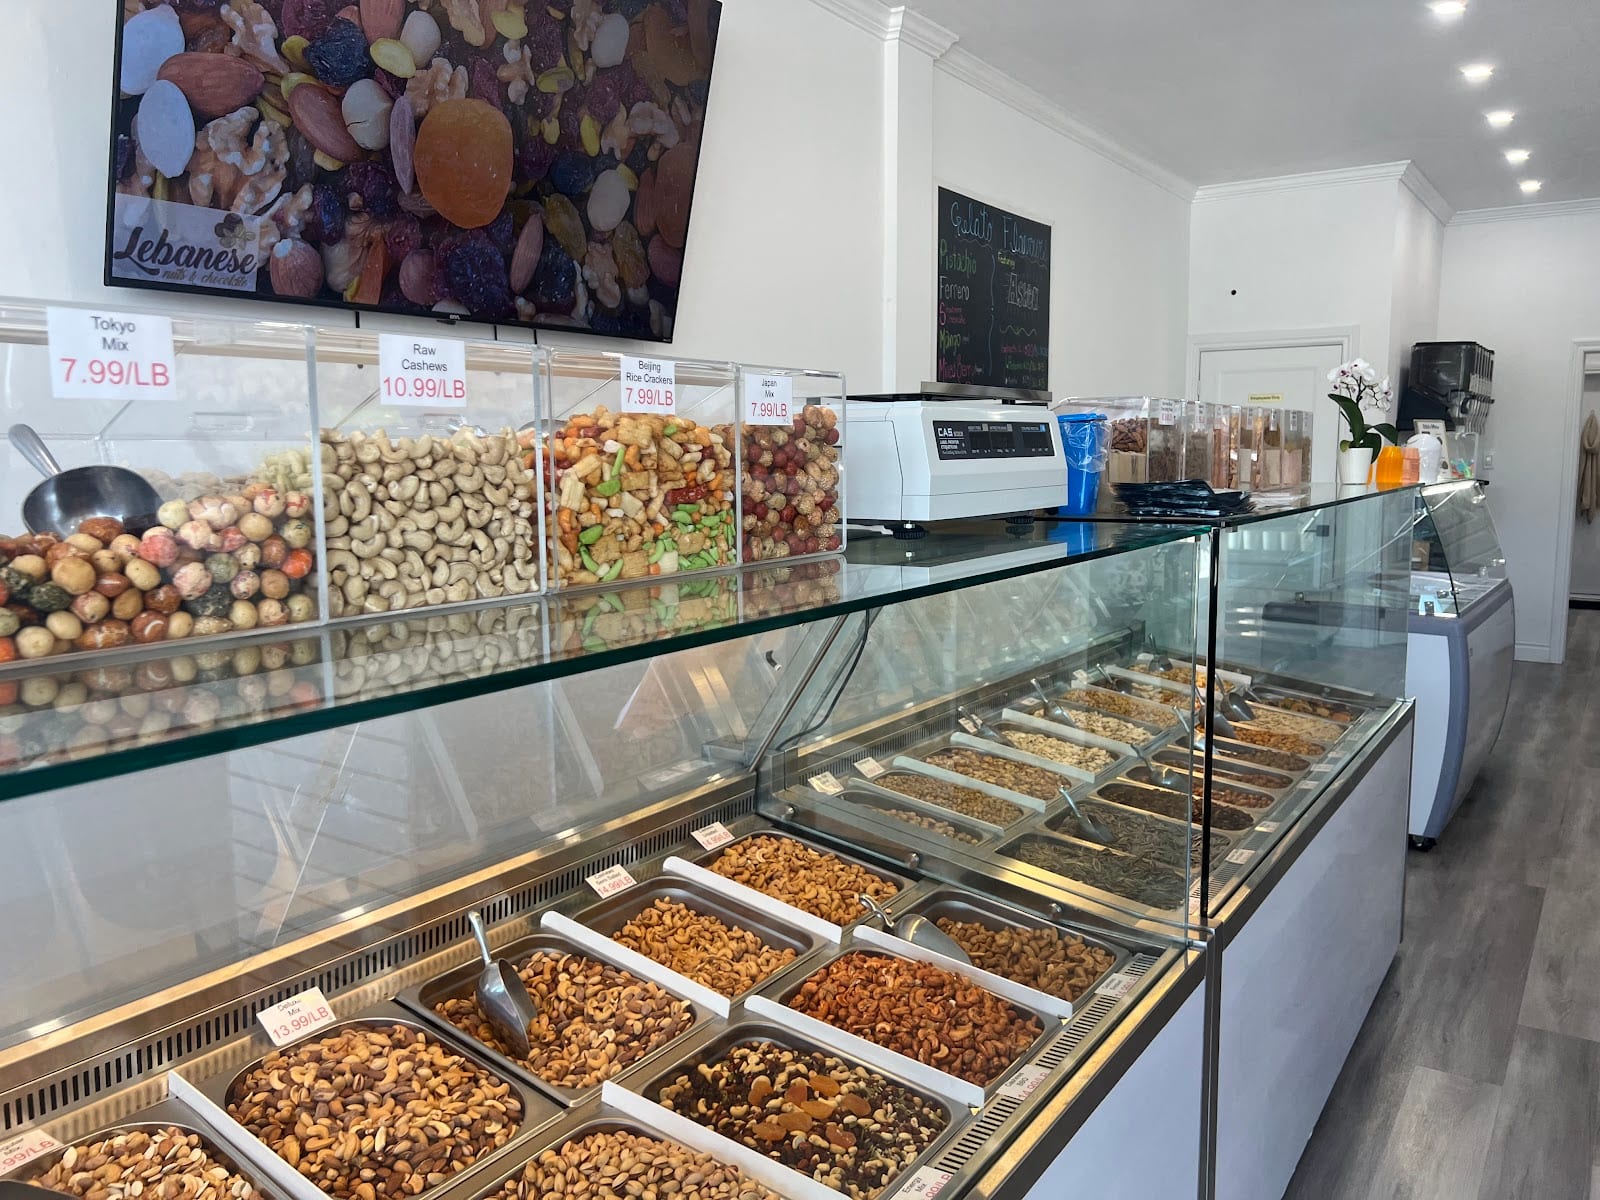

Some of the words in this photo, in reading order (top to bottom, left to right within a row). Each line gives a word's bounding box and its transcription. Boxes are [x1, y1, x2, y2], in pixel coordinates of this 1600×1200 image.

[114, 226, 257, 275] Lebanese
[939, 276, 969, 301] Ferrero
[91, 315, 136, 334] Tokyo
[102, 337, 129, 352] Mix
[413, 343, 437, 357] Raw
[60, 358, 170, 387] 7.99/LB
[401, 358, 448, 373] Cashews
[638, 360, 661, 374] Beijing
[626, 373, 643, 383] Rice
[644, 374, 673, 385] Crackers
[761, 378, 777, 388] Japan
[383, 376, 466, 400] 10.99/LB
[765, 390, 774, 398] Mix
[626, 387, 673, 406] 7.99/LB
[752, 402, 787, 417] 7.99/LB
[938, 427, 953, 437] CAS
[287, 1007, 302, 1016] Mix
[273, 1006, 329, 1039] 13.99/LB
[902, 1176, 922, 1193] Energy
[915, 1183, 928, 1193] Mix
